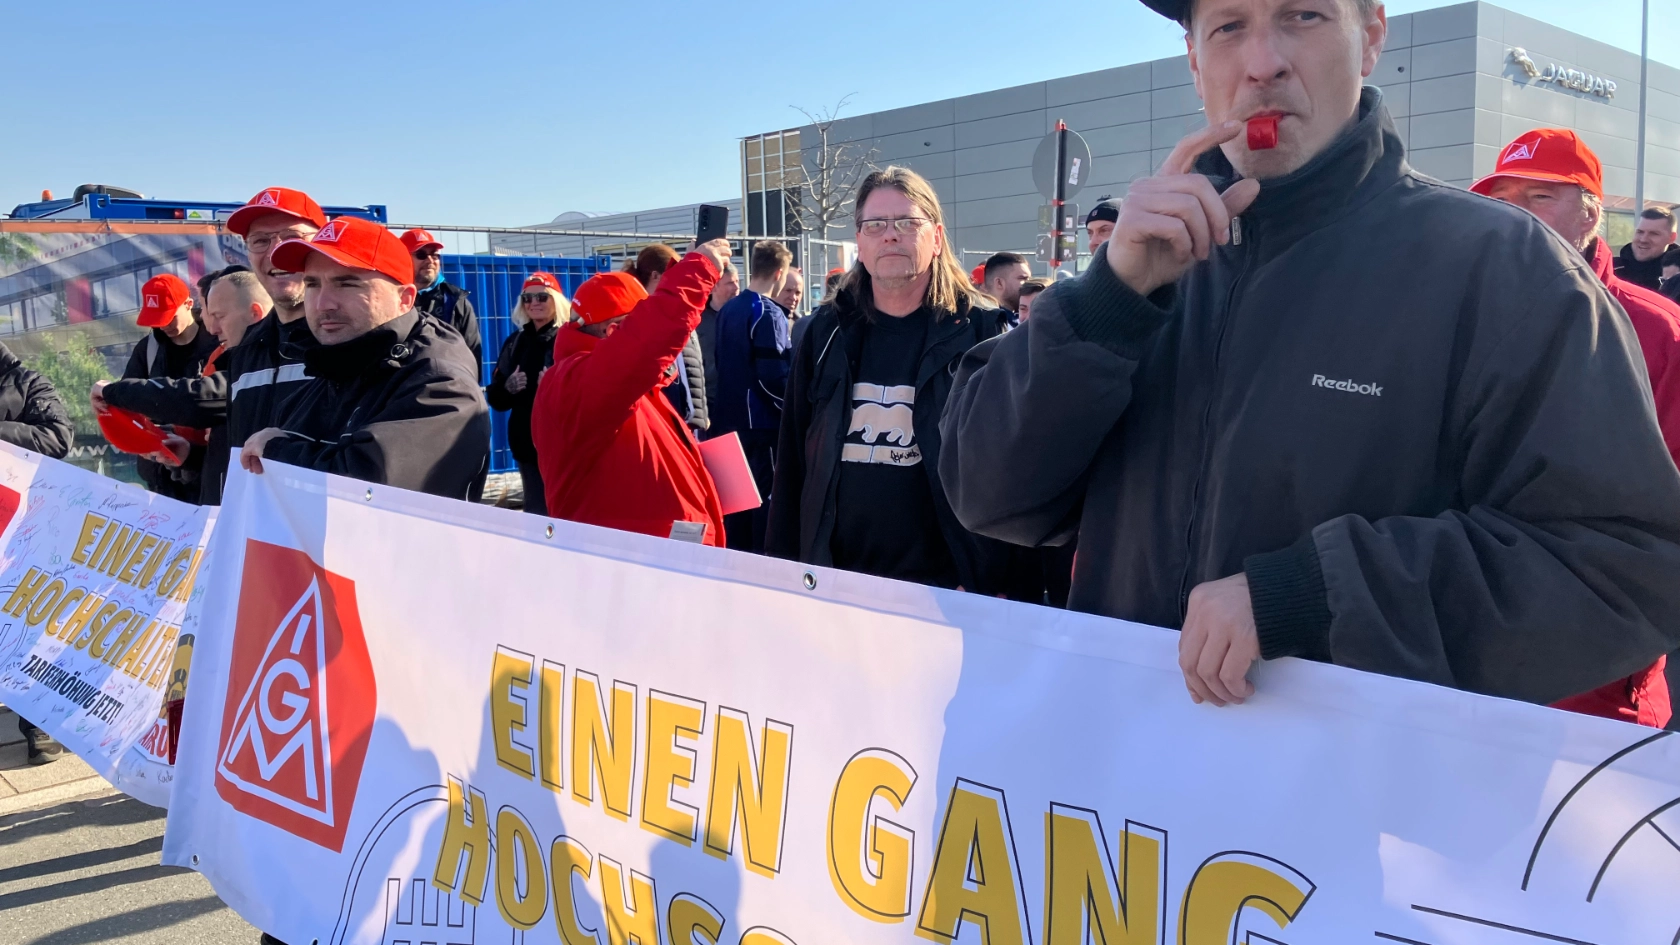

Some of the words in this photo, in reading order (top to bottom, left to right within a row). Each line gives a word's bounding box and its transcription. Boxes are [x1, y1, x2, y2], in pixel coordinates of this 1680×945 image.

[1541, 63, 1617, 99] JAGUAR
[1311, 374, 1383, 396] Reebok
[70, 510, 175, 590] EINEN
[156, 543, 204, 604] GA
[1, 565, 182, 692] HOCHSCHALTE
[20, 654, 102, 709] TARIFERHÖHUNG
[489, 643, 794, 879] EINEN
